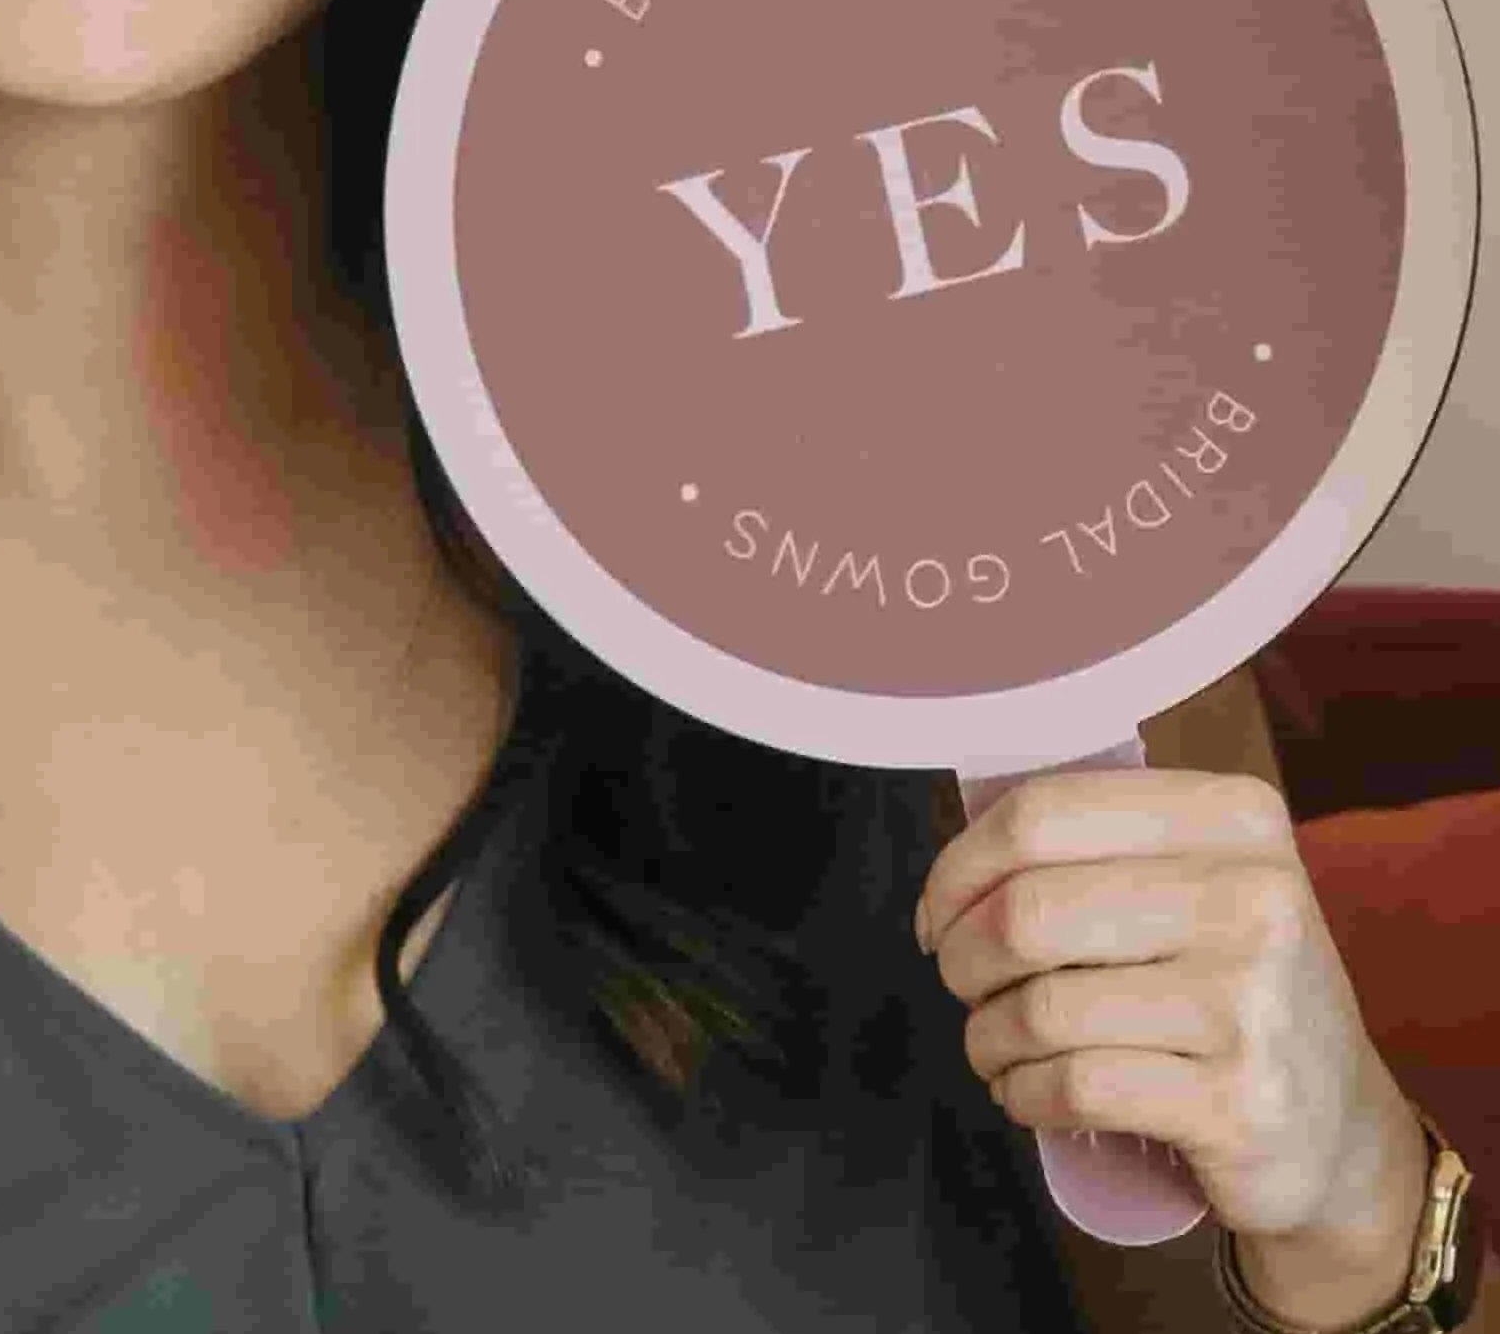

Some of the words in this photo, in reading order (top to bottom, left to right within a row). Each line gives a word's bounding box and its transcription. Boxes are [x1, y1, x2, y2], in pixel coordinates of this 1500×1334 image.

[656, 60, 1192, 341] YES
[723, 509, 1011, 610] GOWNS
[1039, 389, 1258, 574] BRIDAL
